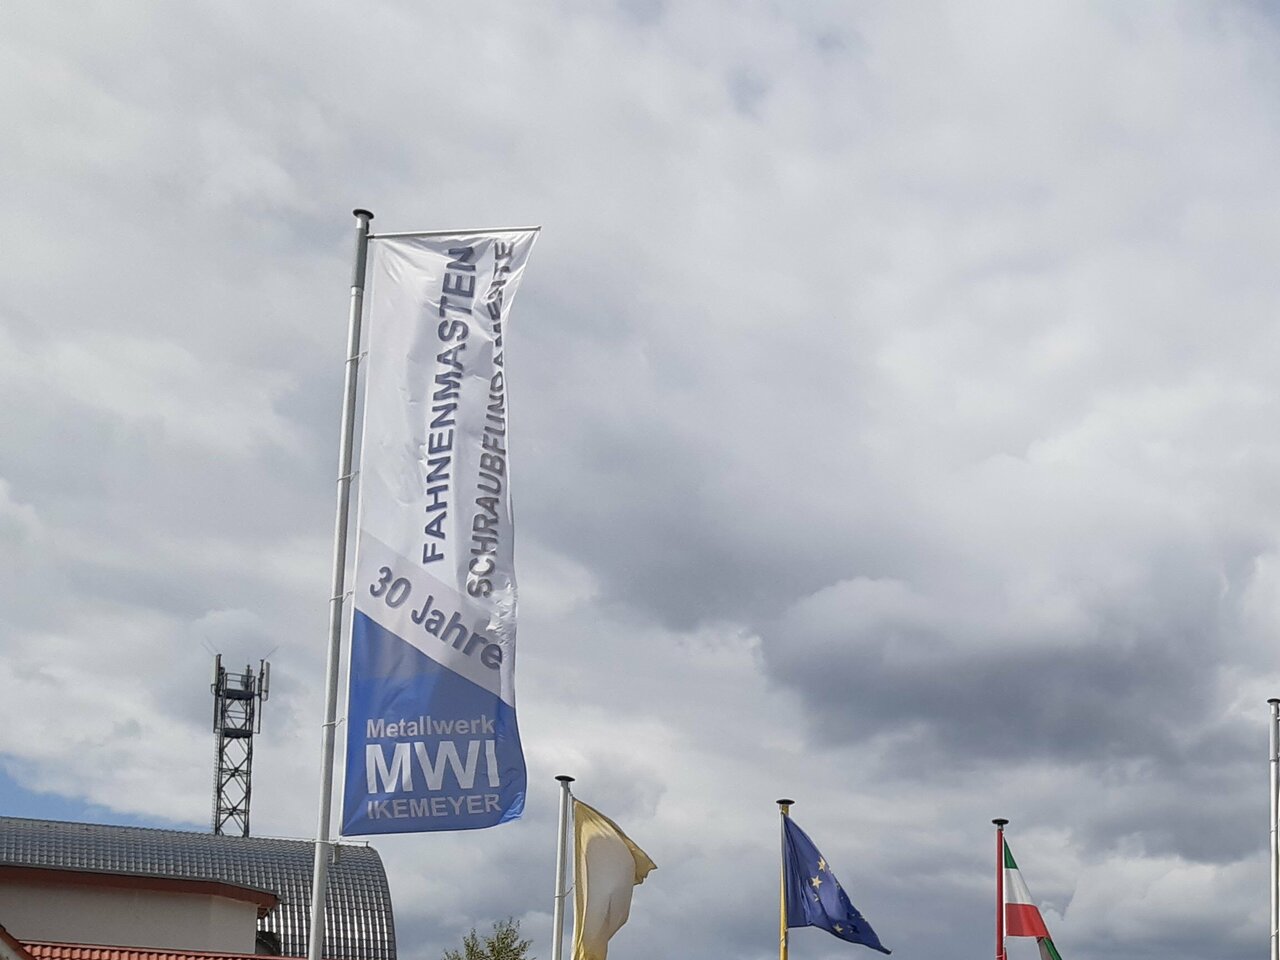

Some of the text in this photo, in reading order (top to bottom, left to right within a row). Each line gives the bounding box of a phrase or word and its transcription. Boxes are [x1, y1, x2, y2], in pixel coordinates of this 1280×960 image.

[422, 246, 477, 564] FAHNENMASTEN
[369, 565, 504, 671] 30 Jahre
[365, 714, 496, 738] Metallwerk
[365, 739, 501, 794] MWI
[366, 794, 502, 820] IKEMEYER
